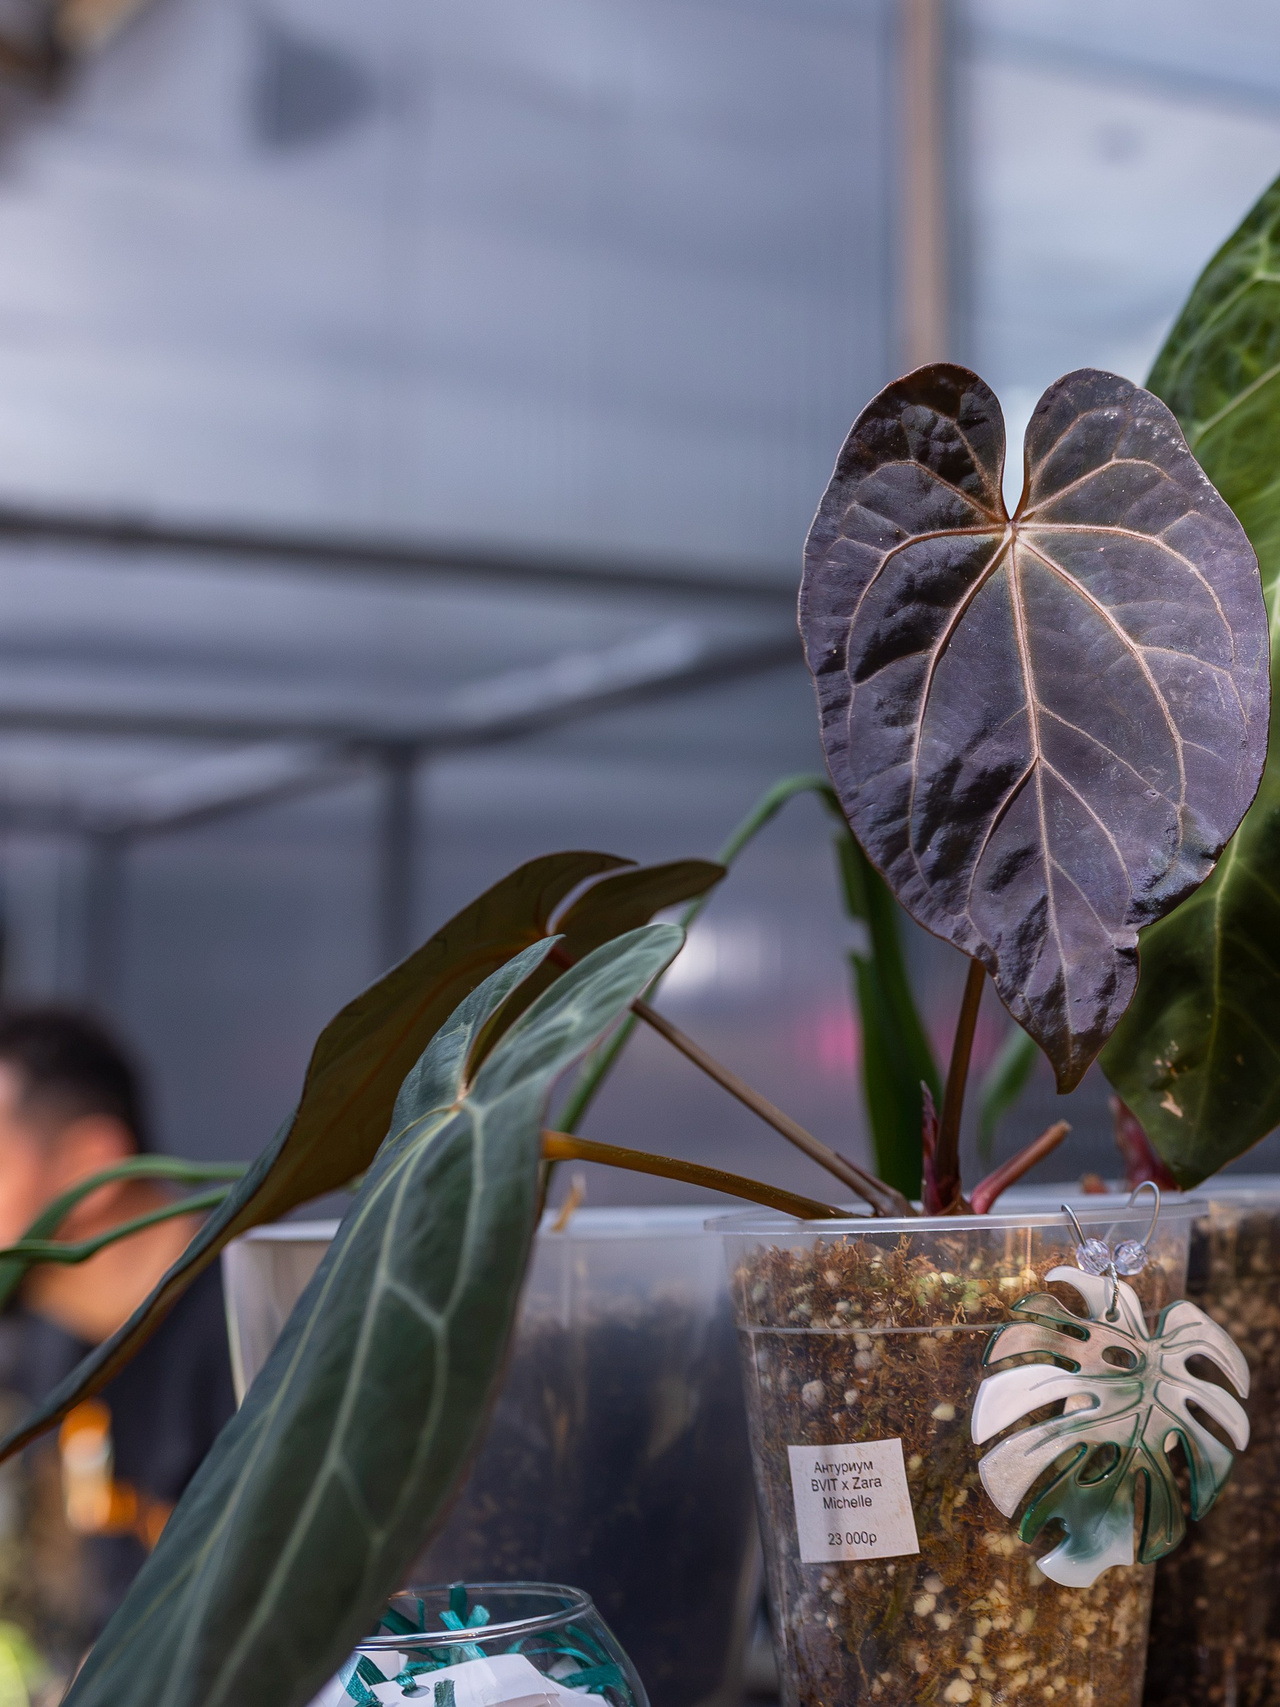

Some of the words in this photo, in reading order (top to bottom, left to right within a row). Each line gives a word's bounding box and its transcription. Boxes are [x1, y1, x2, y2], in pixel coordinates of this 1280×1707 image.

[814, 1461, 874, 1476] Антуриум
[811, 1478, 837, 1492] BVIT
[842, 1481, 850, 1490] x
[852, 1476, 882, 1490] Zara
[823, 1495, 873, 1510] Michelle
[828, 1533, 843, 1546] 23
